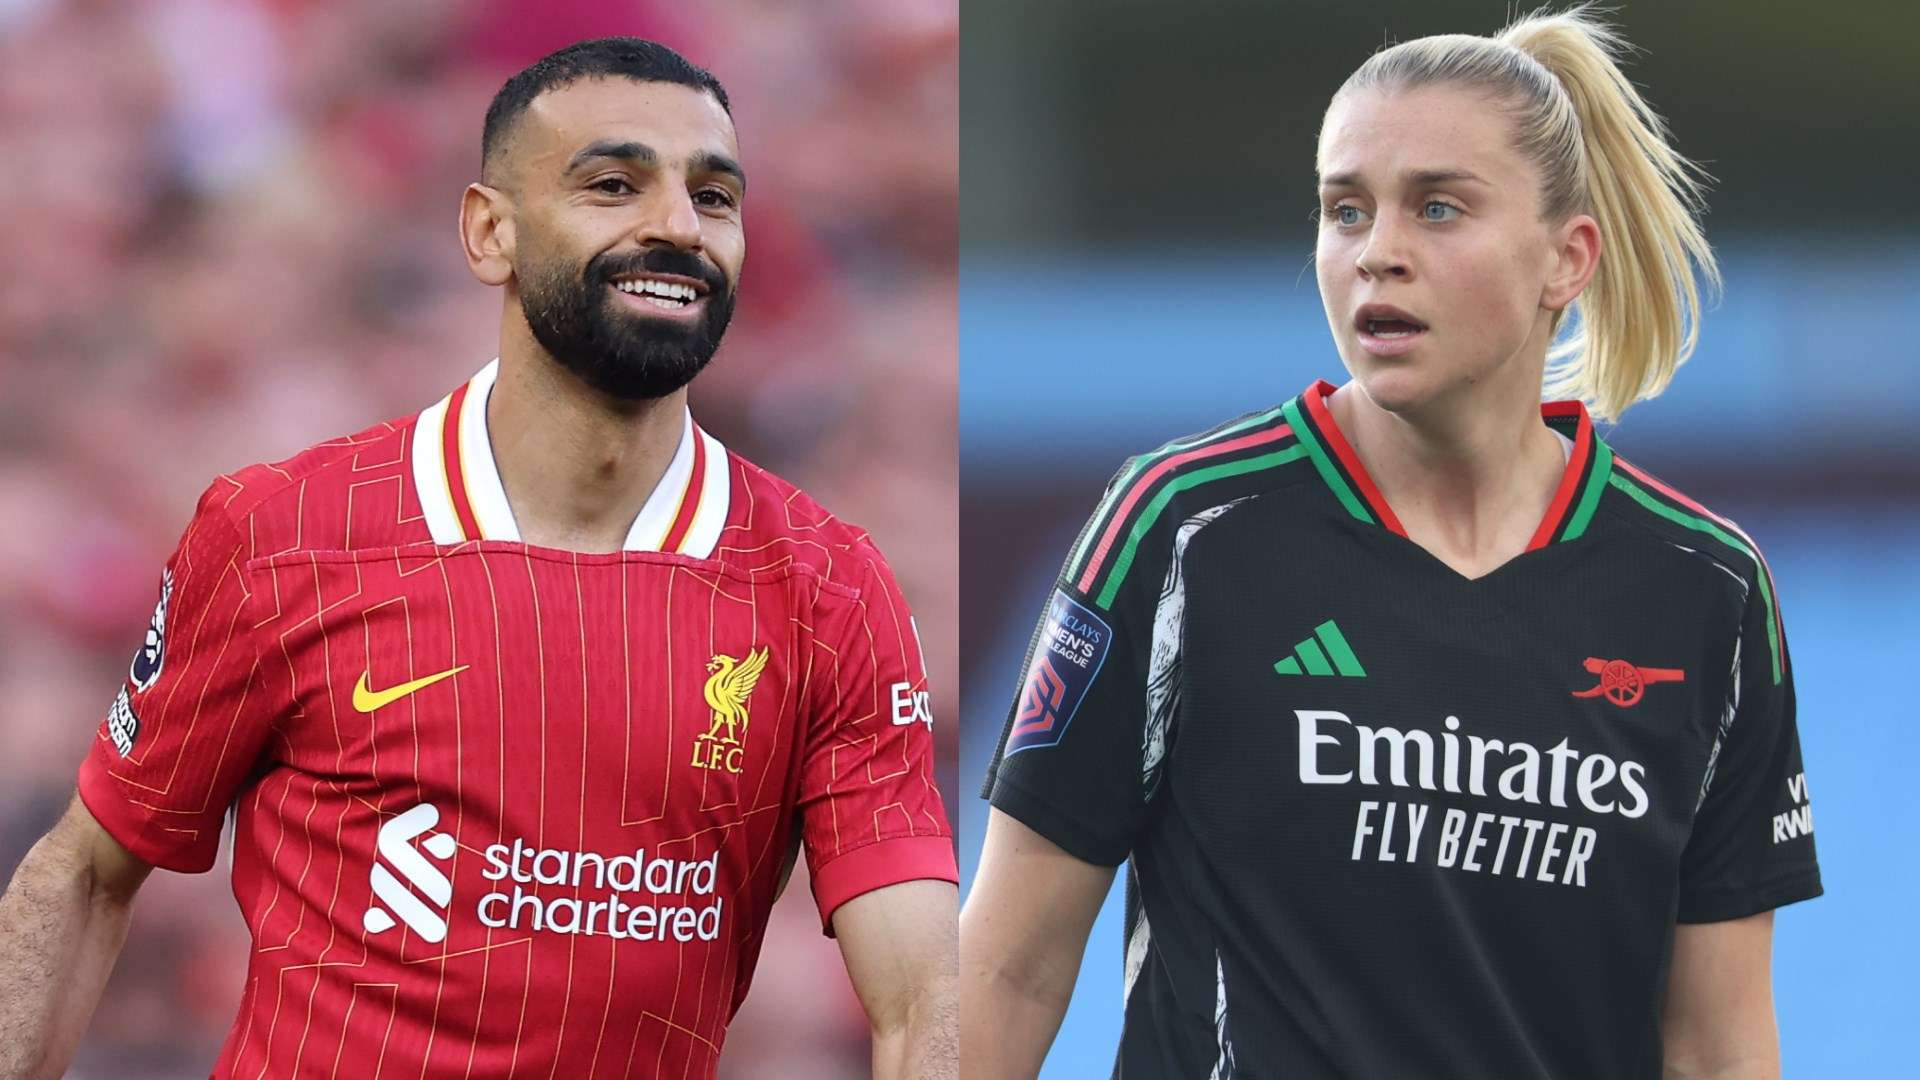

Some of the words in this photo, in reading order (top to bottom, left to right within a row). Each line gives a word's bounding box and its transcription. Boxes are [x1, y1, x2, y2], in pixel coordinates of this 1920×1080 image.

[690, 741, 744, 774] L.F.C.
[1293, 709, 1650, 819] Emirates
[481, 837, 720, 895] standard
[1351, 801, 1429, 863] FLY
[1437, 807, 1597, 888] BETTER
[476, 885, 723, 942] chartered
